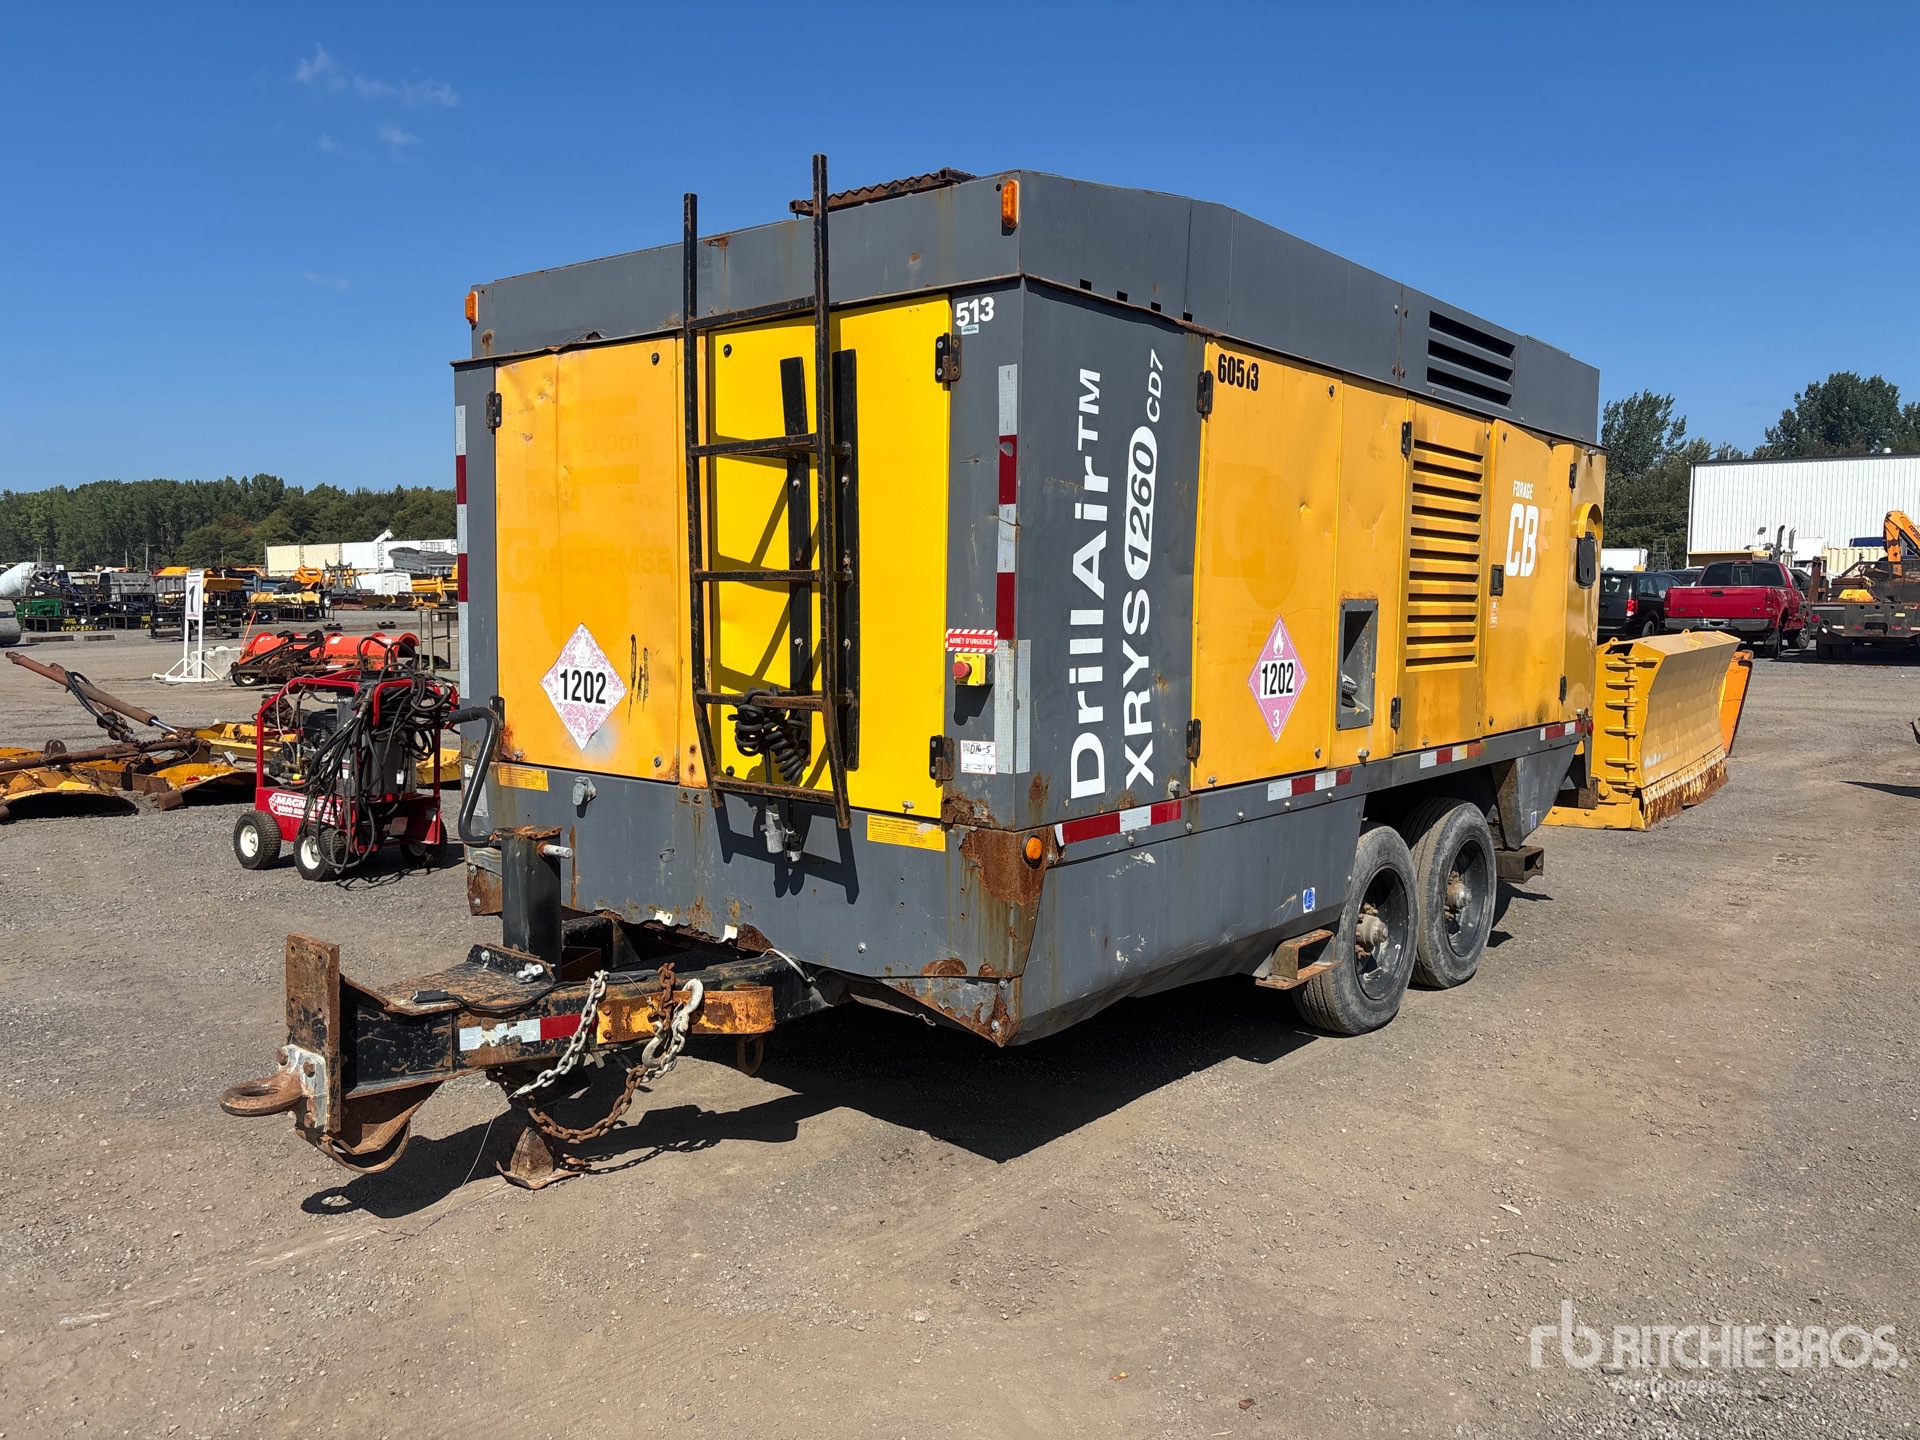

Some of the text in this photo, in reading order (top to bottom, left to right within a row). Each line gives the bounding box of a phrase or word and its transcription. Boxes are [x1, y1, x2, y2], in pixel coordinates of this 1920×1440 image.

[956, 296, 995, 327] 513
[1218, 353, 1259, 391] 60513
[1505, 502, 1539, 577] CB
[1122, 348, 1164, 790] XRYS 1260 CD7
[189, 585, 196, 612] 1
[949, 636, 965, 645] ARRÊT
[559, 668, 607, 704] 1202
[1261, 662, 1294, 696] 1202
[1273, 709, 1280, 728] 3
